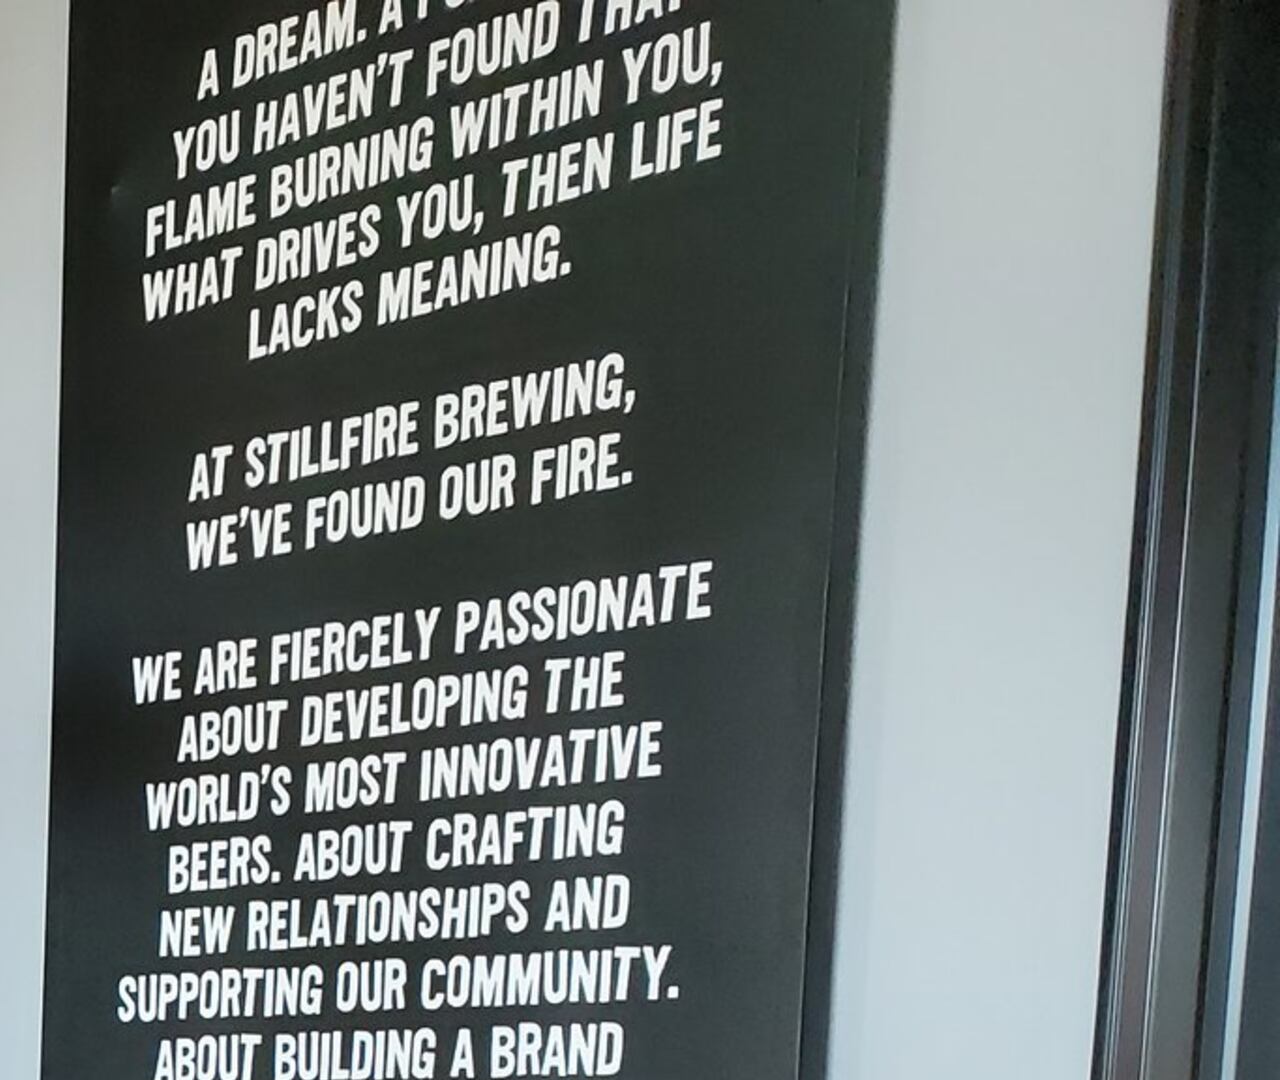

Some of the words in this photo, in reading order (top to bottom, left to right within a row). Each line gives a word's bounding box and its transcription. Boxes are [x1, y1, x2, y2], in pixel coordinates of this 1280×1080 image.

[173, 109, 241, 180] YOU
[252, 48, 414, 155] HAVEN'T
[426, 0, 560, 97] FOUND
[578, 0, 681, 43] TH
[197, 48, 220, 101] A
[232, 0, 367, 89] DREAM.
[145, 173, 257, 258] FLAME
[270, 115, 435, 219] BURNING
[450, 58, 605, 160] WITHIN
[621, 20, 723, 105] YOU,
[142, 246, 244, 322] WHAT
[254, 203, 382, 291] DRIVES
[396, 173, 484, 248] YOU,
[501, 132, 615, 218] THEN
[629, 97, 724, 181] LIFE
[248, 279, 364, 361] LACKS
[377, 224, 572, 326] MEANING.
[188, 444, 234, 503] AT
[244, 400, 420, 489] STILLFIRE
[434, 352, 636, 449] BREWING,
[186, 502, 293, 572] WE'VE
[304, 475, 426, 550] FOUND
[439, 453, 517, 520] OUR
[530, 432, 633, 506] FIRE.
[132, 651, 182, 705] WE
[193, 638, 258, 696] ARE
[269, 606, 442, 686] FIERCELY
[454, 560, 713, 655] PASSIONATE
[176, 699, 289, 763] ABOUT
[300, 664, 529, 747] DEVELOPING
[544, 650, 625, 714] THE
[145, 763, 292, 831] WORLD'S
[304, 751, 407, 814] MOST
[419, 720, 663, 802] INNOVATIVE
[168, 834, 281, 895] BEERS.
[293, 820, 413, 882] ABOUT
[425, 799, 625, 871] CRAFTING
[158, 905, 236, 958] NEW
[246, 879, 531, 952] RELATIONSHIPS
[543, 873, 631, 933] AND
[117, 964, 324, 1023] SUPPORTING
[336, 957, 408, 1013] OUR
[420, 944, 680, 1011] COMMUNITY.
[449, 1027, 475, 1079] A
[490, 1021, 624, 1079] BRAND
